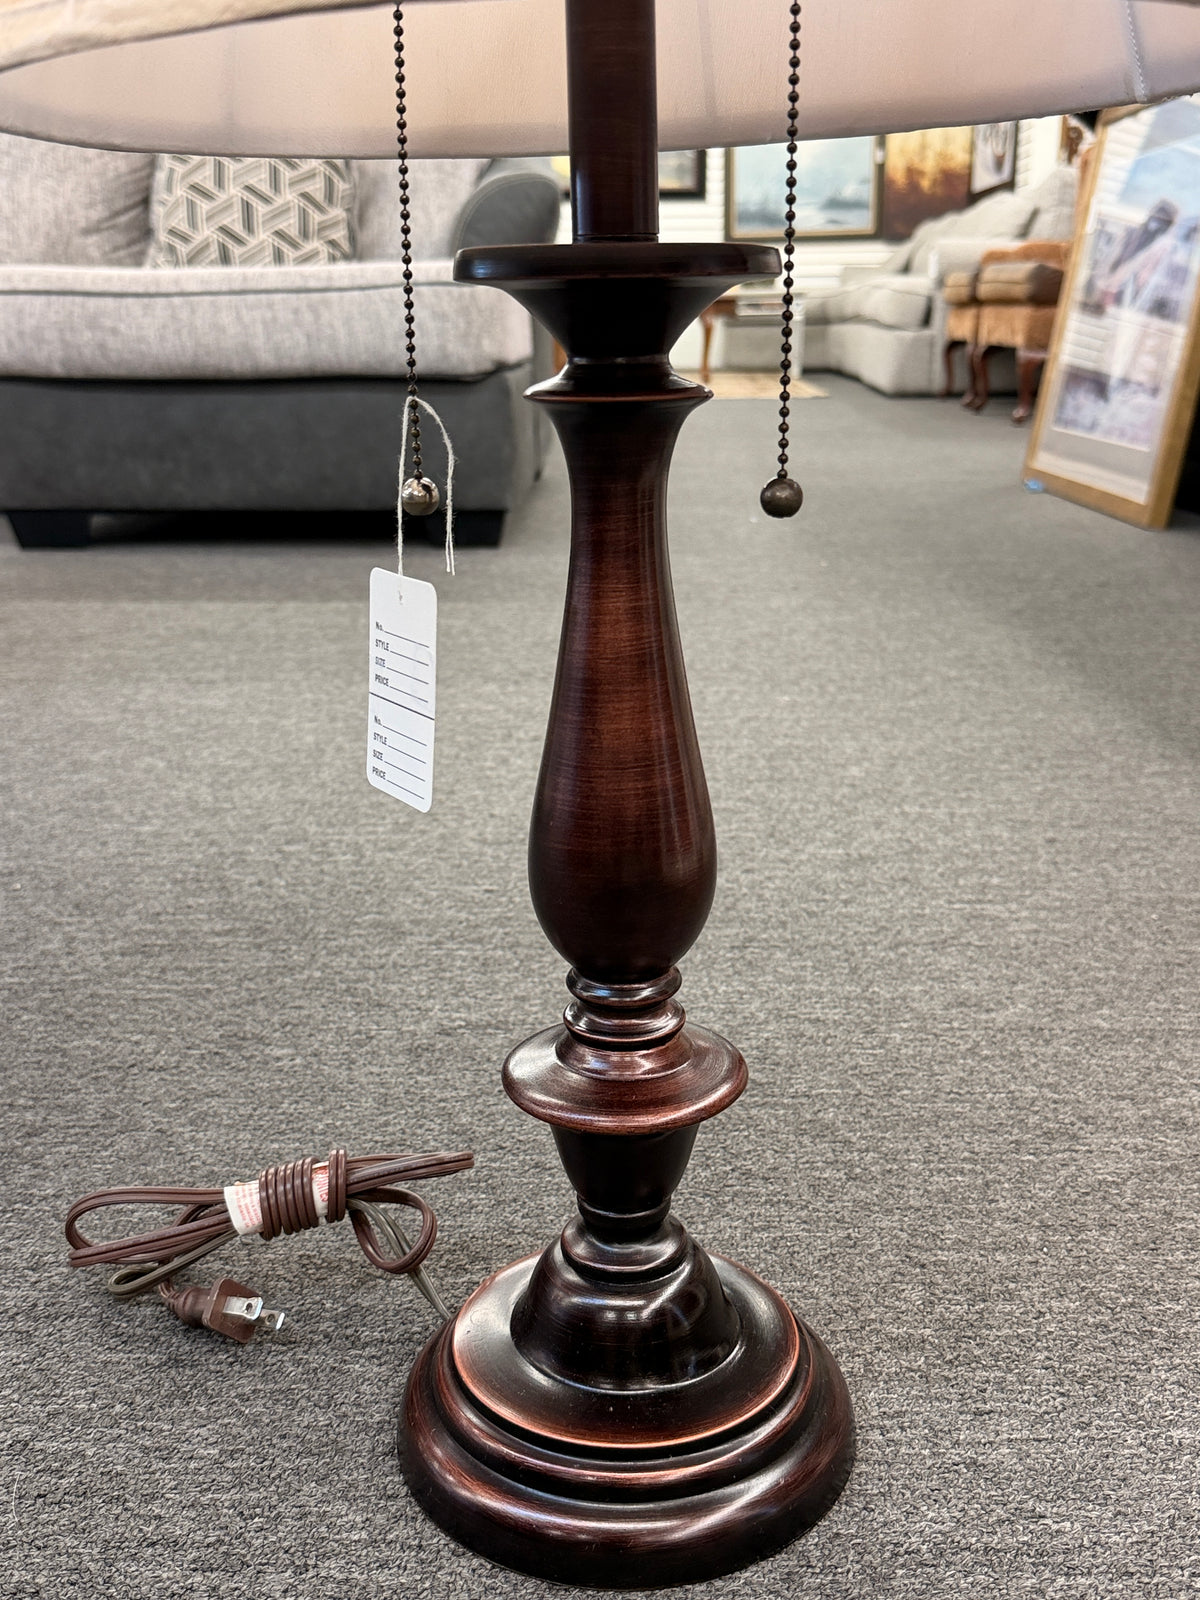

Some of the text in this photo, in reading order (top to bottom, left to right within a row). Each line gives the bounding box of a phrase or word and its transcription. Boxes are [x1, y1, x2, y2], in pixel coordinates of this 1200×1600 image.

[375, 638, 389, 652] STYLE
[375, 673, 389, 687] PRICE
[373, 732, 387, 746] STYLE
[373, 749, 384, 762] SIZE
[372, 766, 386, 780] PRICE
